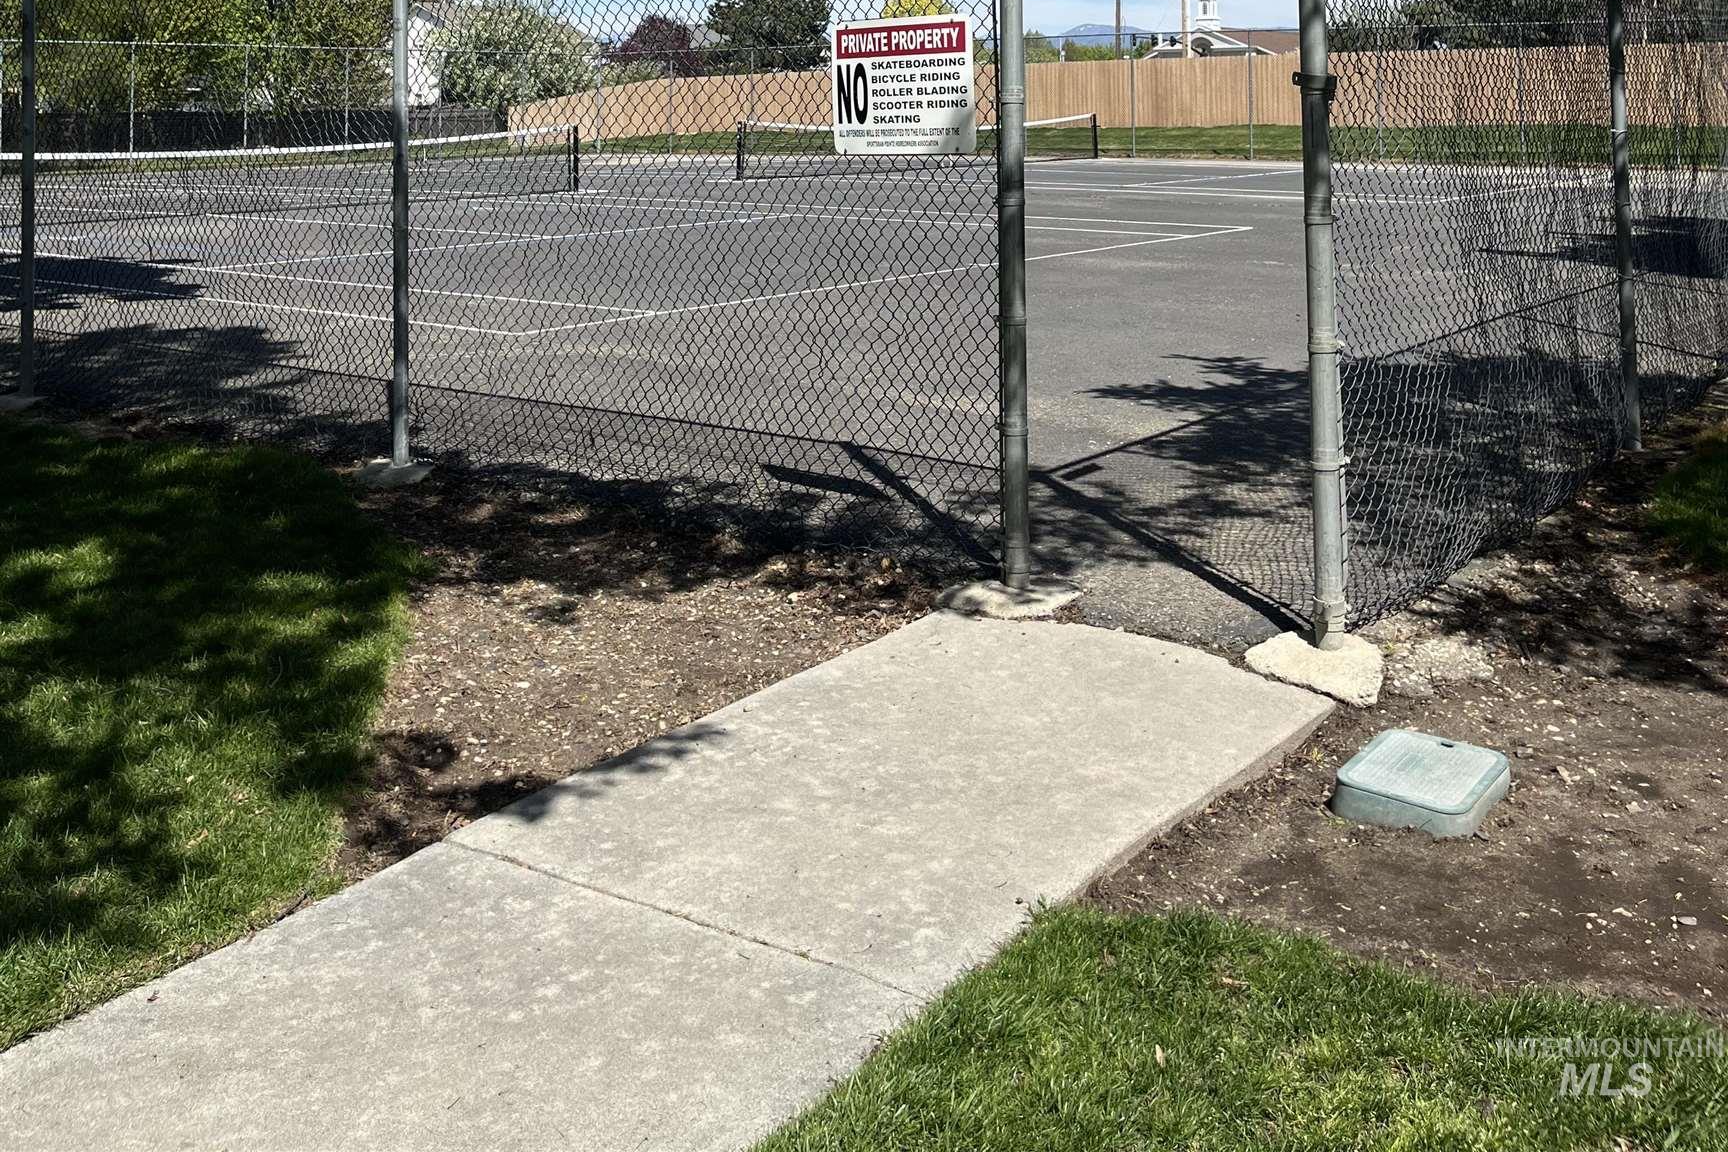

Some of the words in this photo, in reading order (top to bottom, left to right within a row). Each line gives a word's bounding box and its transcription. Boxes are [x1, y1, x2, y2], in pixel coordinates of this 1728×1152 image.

[841, 32, 888, 54] PRIVATE
[891, 27, 960, 51] PROPERTY
[871, 57, 966, 70] SKATEBOARDING
[871, 73, 916, 84] BICYCLE
[920, 72, 960, 82] RIDING
[836, 62, 868, 125] NO
[872, 87, 913, 97] ROLLER
[916, 85, 968, 96] BLADING
[872, 100, 923, 110] SCOOTER
[927, 99, 968, 109] RIDING
[873, 115, 921, 125] SKATING
[866, 129, 875, 138] WILL
[875, 129, 881, 137] BE
[881, 128, 904, 137] PROSECUTED
[904, 128, 910, 137] TO
[910, 128, 918, 136] THE
[919, 128, 929, 136] FULL
[929, 127, 944, 136] EXTENT
[945, 127, 951, 136] OF
[952, 127, 960, 136] THE
